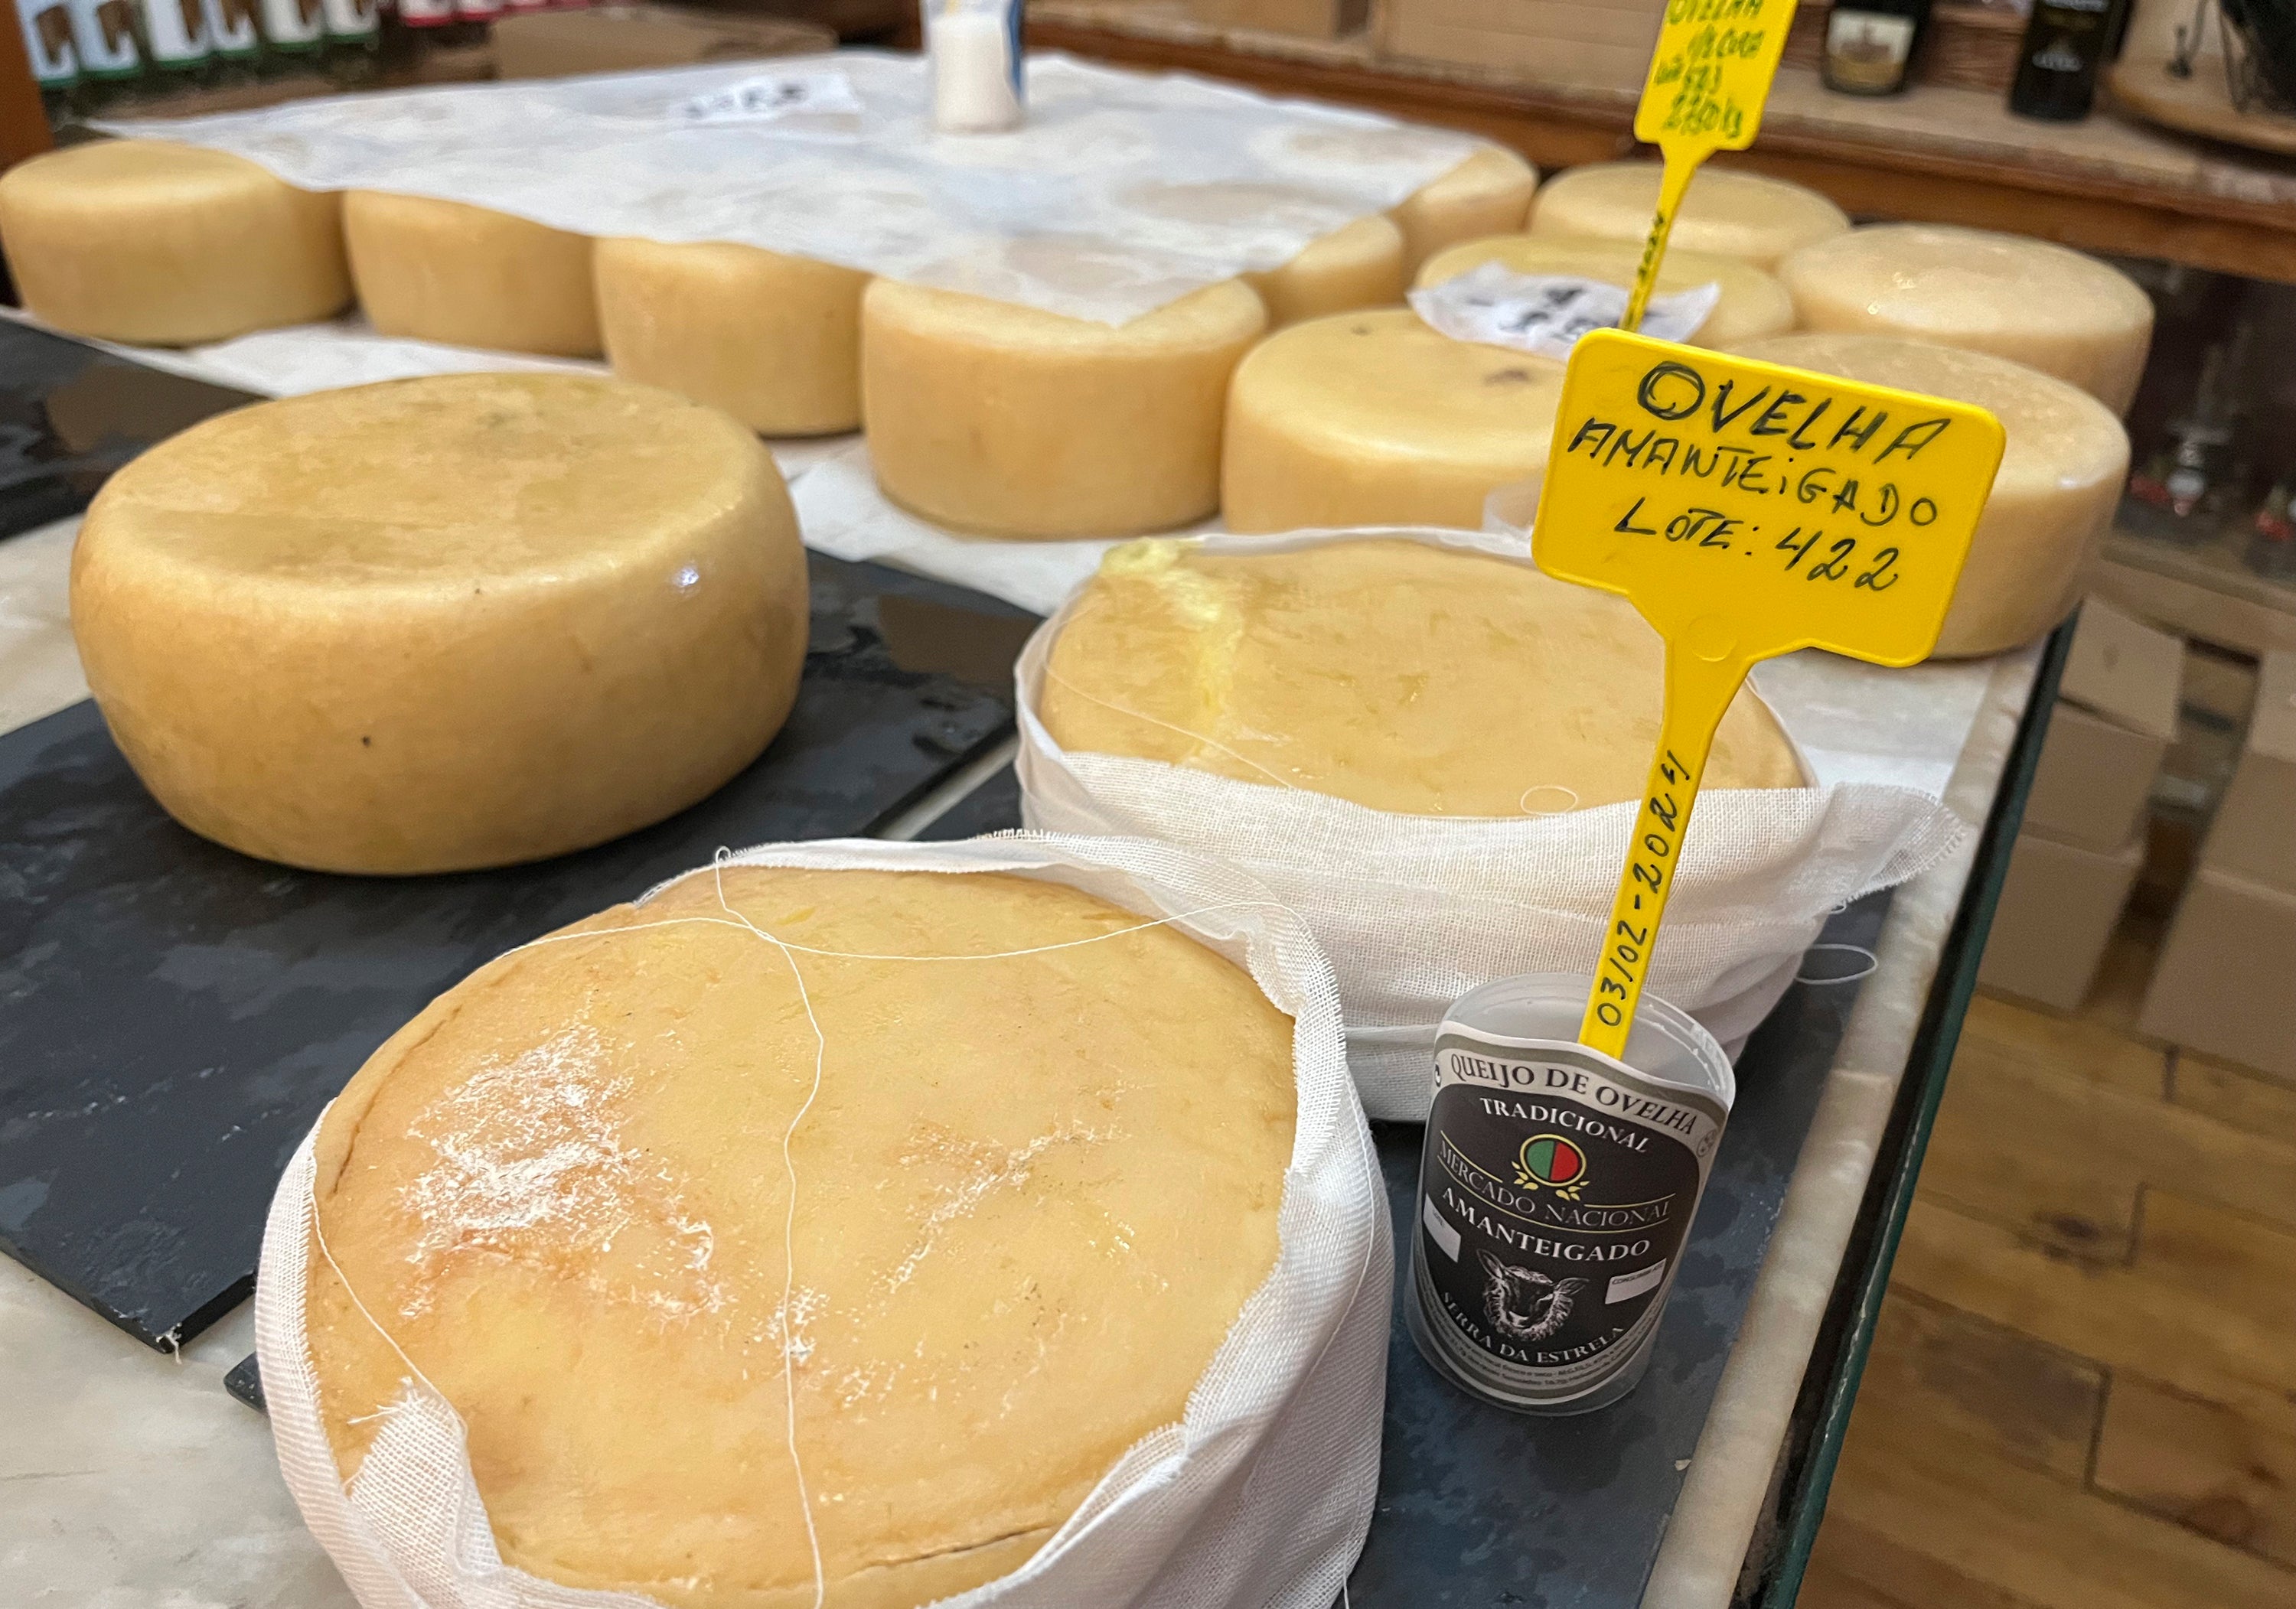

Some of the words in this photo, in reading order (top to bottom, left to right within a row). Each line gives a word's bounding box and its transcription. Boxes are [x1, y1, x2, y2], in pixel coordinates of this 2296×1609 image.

[1637, 360, 1952, 464] OVELHA
[1614, 497, 1759, 555] LOTE:
[1775, 527, 1899, 591] 422
[1451, 1054, 1534, 1088] QUEIJO
[1545, 1068, 1589, 1094] DE
[1596, 1086, 1697, 1135] OVELHA
[1480, 1098, 1649, 1152] TRADICIONAL
[1440, 1140, 1535, 1213] MERCADO
[1545, 1201, 1669, 1226] NACIONAL
[1443, 1187, 1650, 1261] AMANTEIGADO
[1500, 1344, 1528, 1361] DA
[1538, 1327, 1624, 1363] ESTRELA
